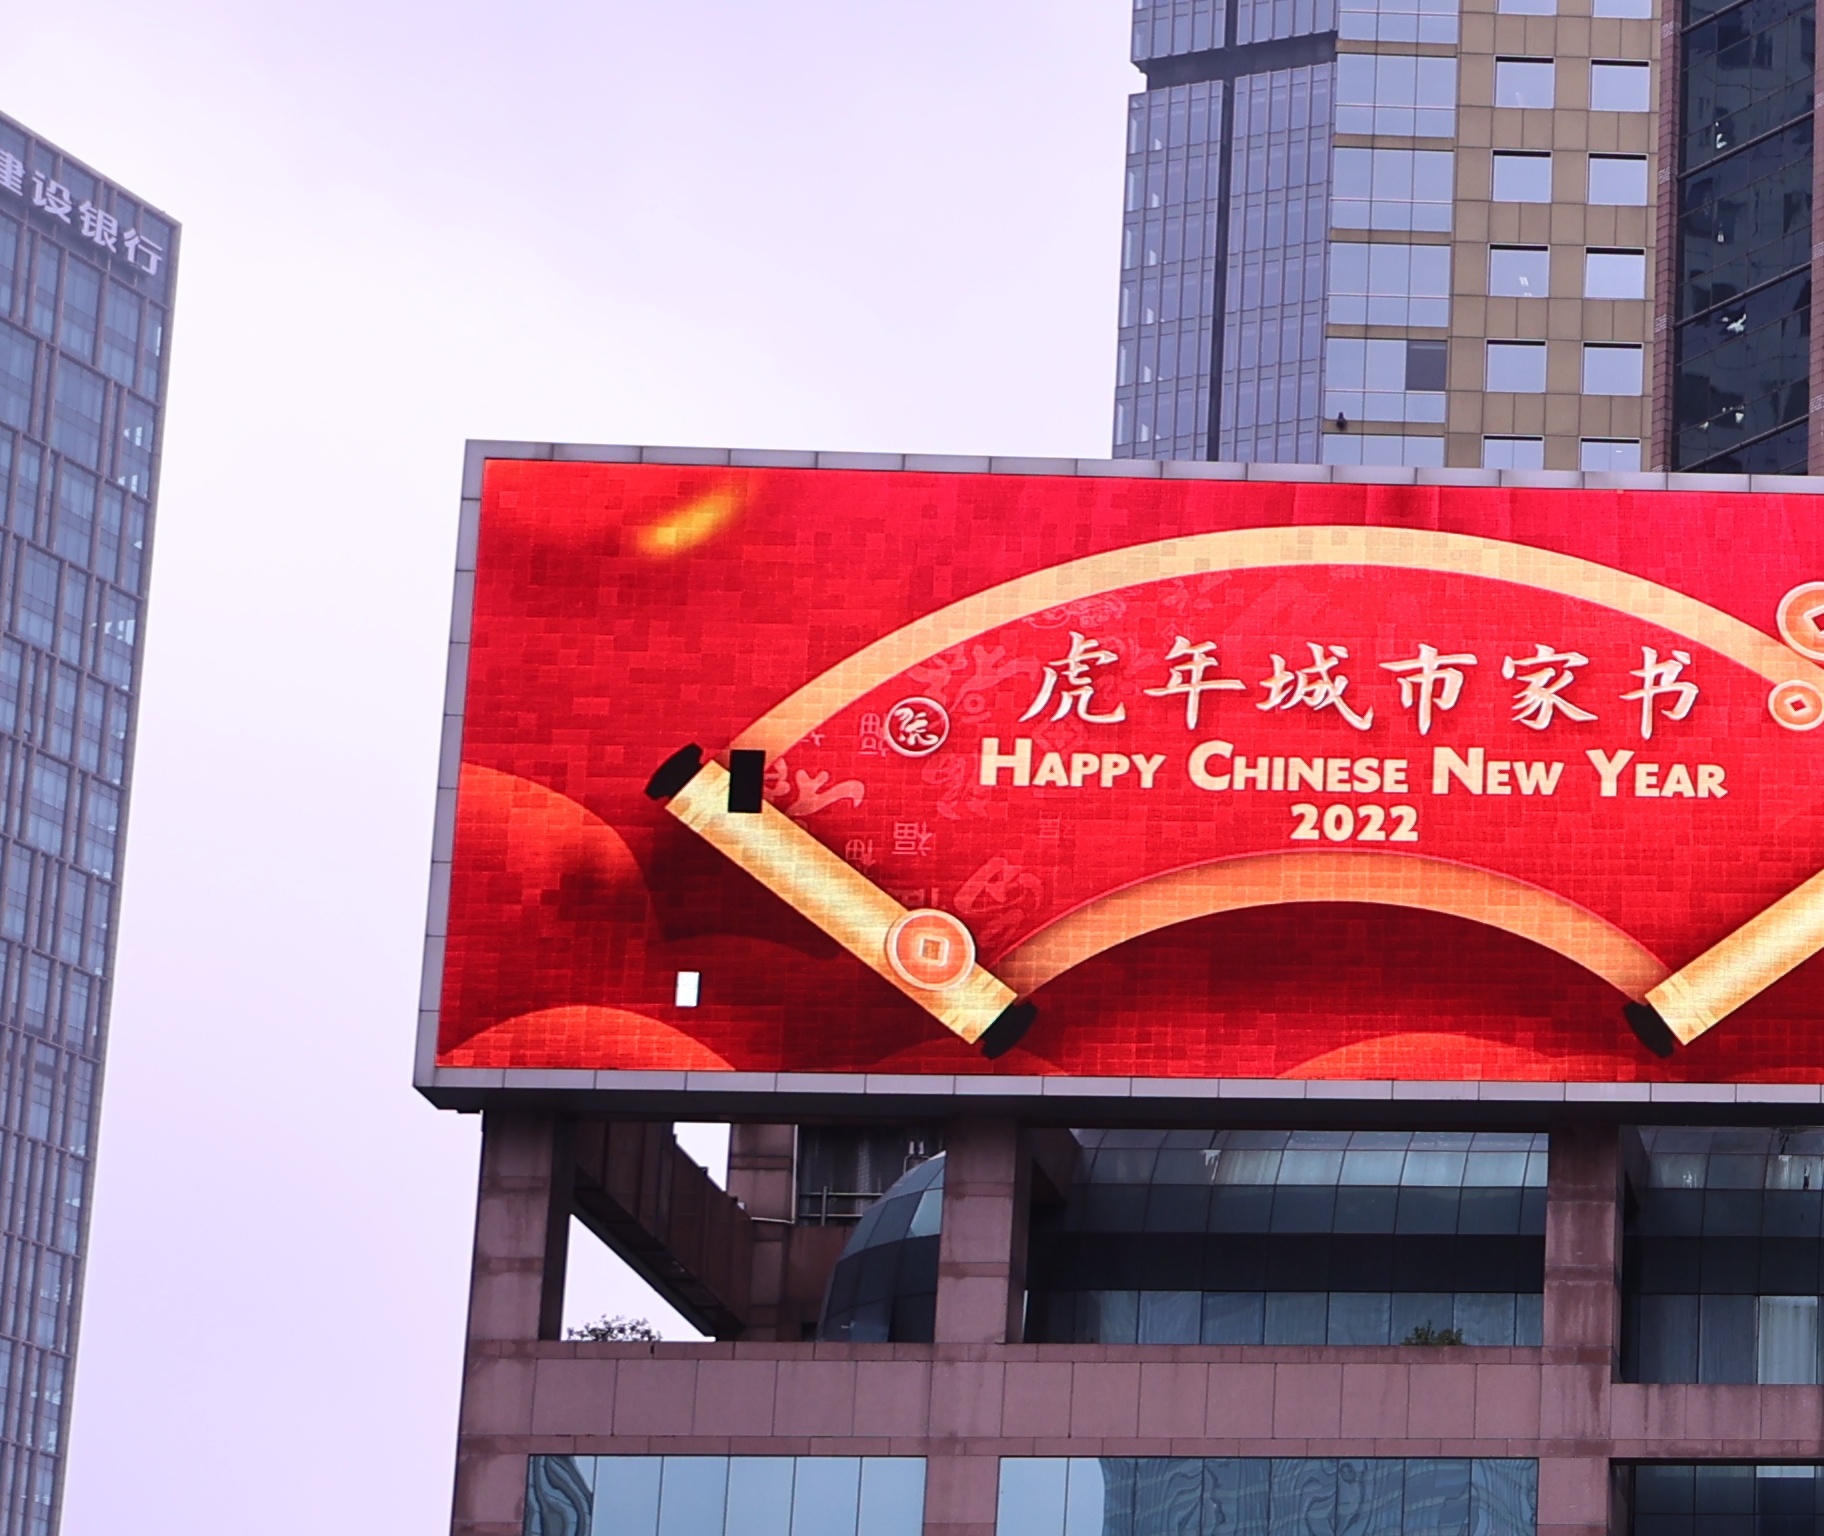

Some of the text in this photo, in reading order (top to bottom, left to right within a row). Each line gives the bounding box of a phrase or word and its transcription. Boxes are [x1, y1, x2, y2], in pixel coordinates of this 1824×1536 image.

[0, 150, 163, 276] 建设银行
[1018, 632, 1701, 740] 虎年城市家书
[1187, 741, 1410, 793] CHINESE
[1432, 746, 1565, 796] NEW
[1585, 749, 1729, 799] YEAR
[1290, 804, 1419, 841] 2022
